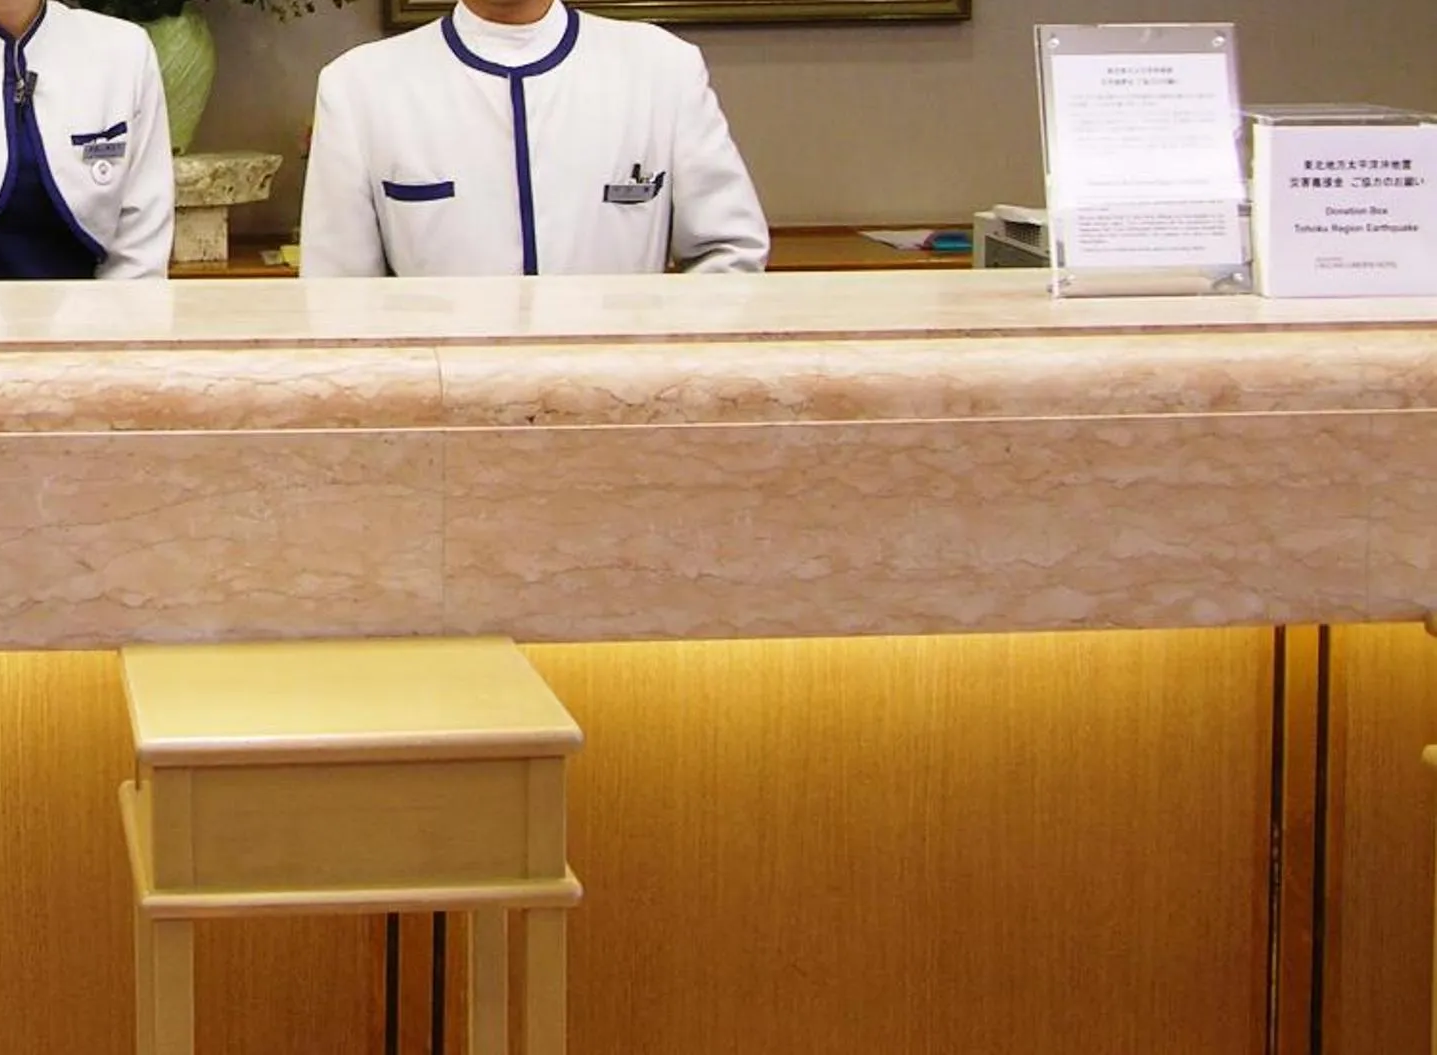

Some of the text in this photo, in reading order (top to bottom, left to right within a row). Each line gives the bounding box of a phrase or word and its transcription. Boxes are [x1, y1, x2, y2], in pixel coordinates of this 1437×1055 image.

[1325, 205, 1388, 216] Donation Box
[1294, 223, 1419, 235] Tohoku Region Earthquake
